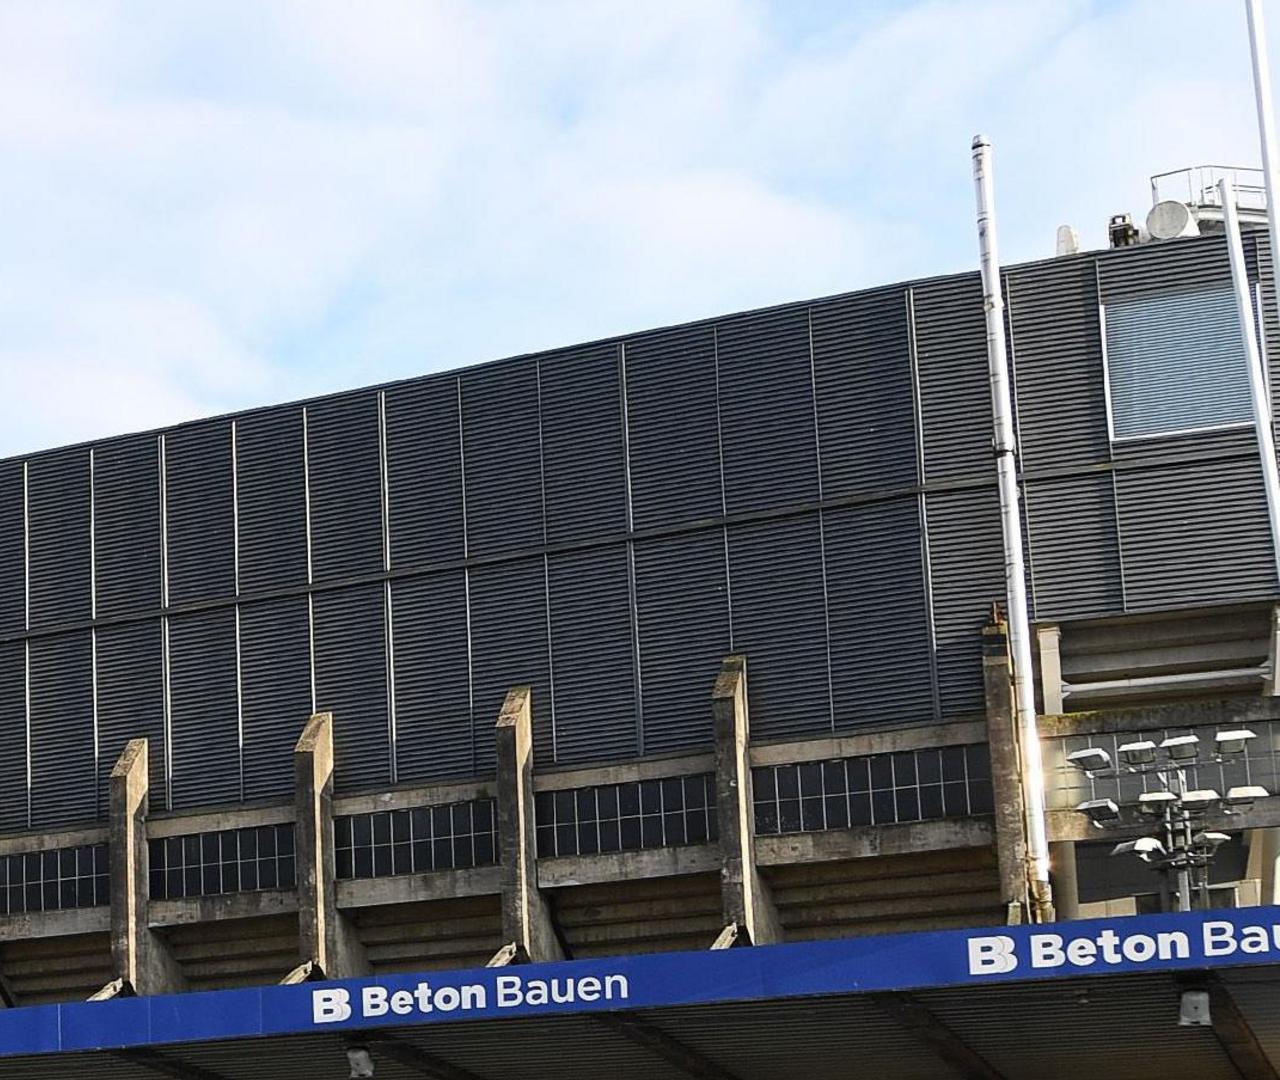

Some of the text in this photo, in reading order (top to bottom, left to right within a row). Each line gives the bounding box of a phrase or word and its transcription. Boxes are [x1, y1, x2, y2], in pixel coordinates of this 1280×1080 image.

[1030, 929, 1190, 968] Beton
[362, 982, 486, 1018] Beton
[496, 974, 628, 1008] Bauen
